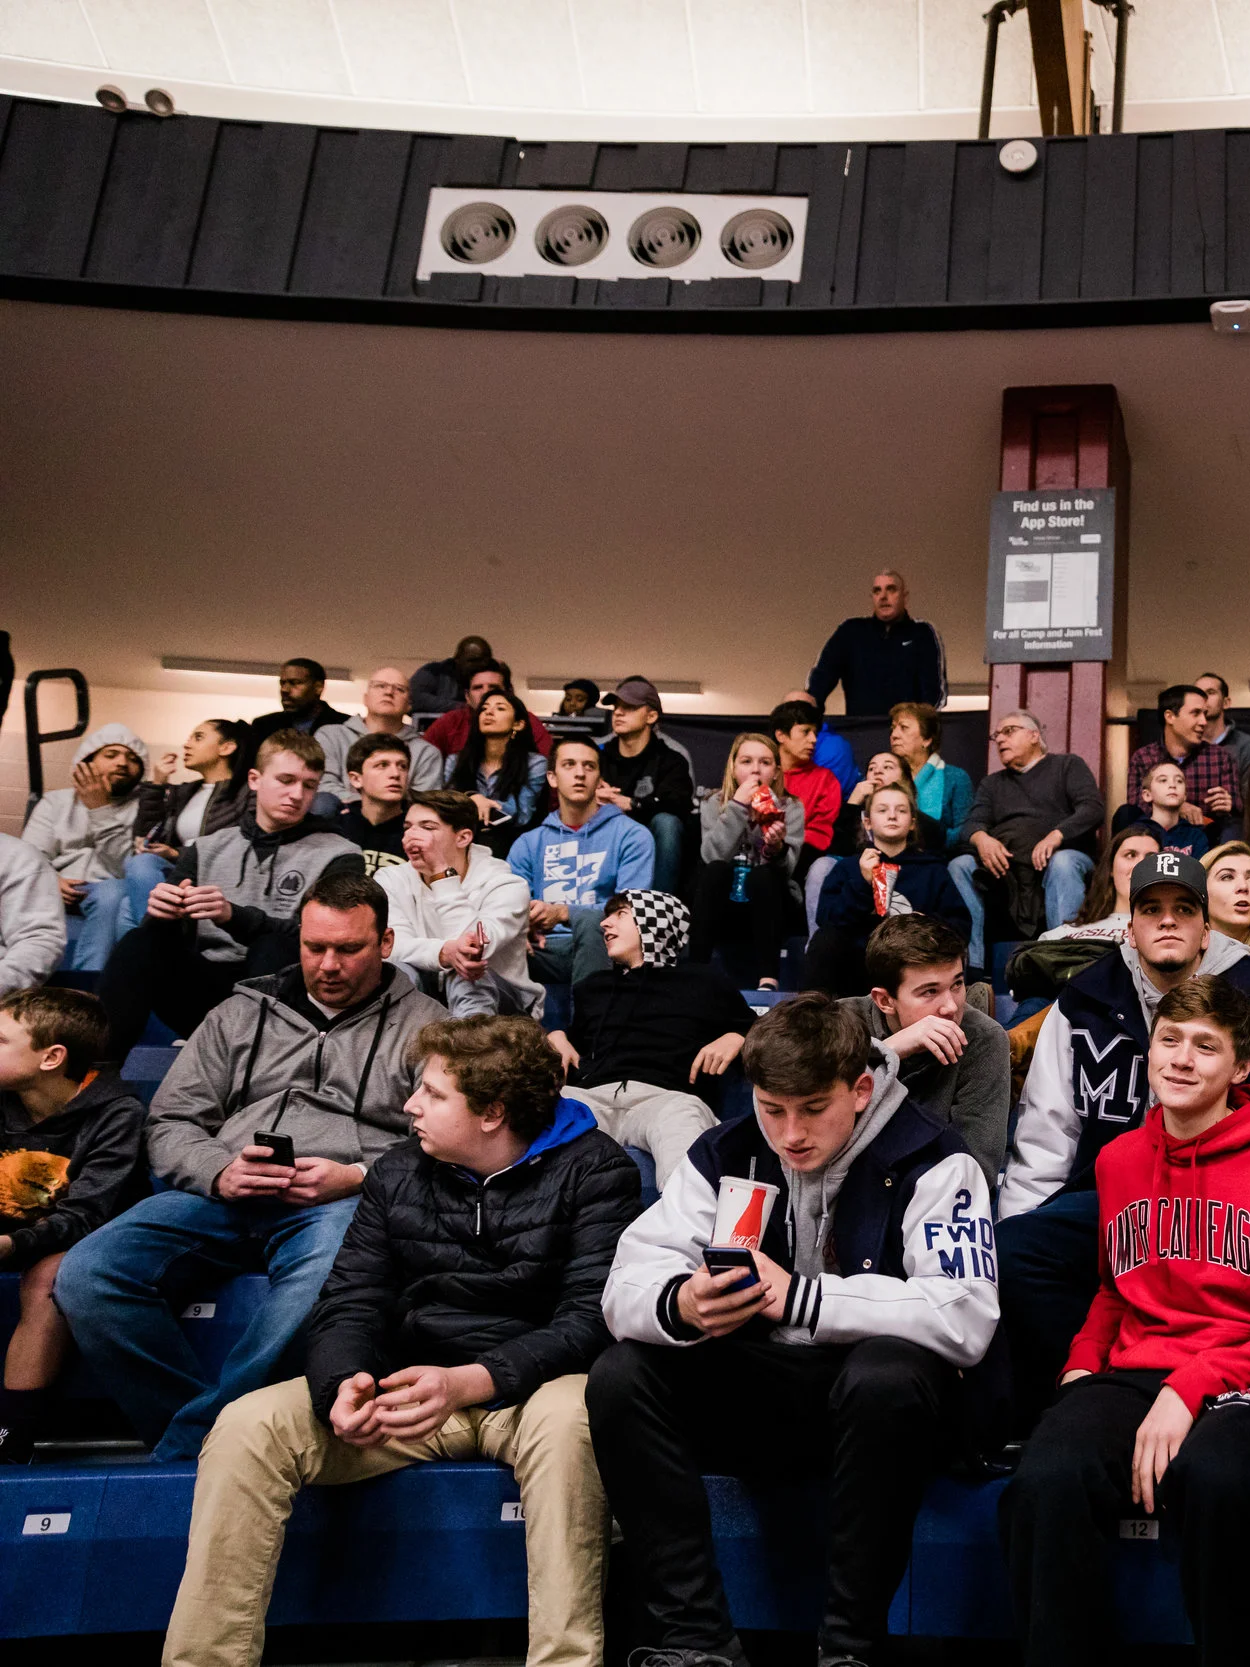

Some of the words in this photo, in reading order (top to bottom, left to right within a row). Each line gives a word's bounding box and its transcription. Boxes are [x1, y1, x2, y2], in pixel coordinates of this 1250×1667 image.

[1012, 500, 1039, 512] Find
[1042, 501, 1057, 512] us
[1060, 499, 1072, 511] in
[1074, 498, 1094, 510] the
[1020, 516, 1045, 530] App
[1048, 514, 1085, 528] Store!
[993, 630, 1007, 639] For
[1008, 629, 1019, 638] all
[1020, 629, 1045, 640] Camp
[1047, 628, 1062, 638] and
[1064, 628, 1083, 638] Jam
[1085, 628, 1103, 637] Fest
[1024, 640, 1073, 650] Information
[952, 1188, 972, 1224] 2
[923, 1217, 994, 1251] FWD
[938, 1246, 997, 1283] MID
[193, 1305, 202, 1316] 9
[40, 1517, 51, 1532] 9
[1131, 1522, 1148, 1537] 12
